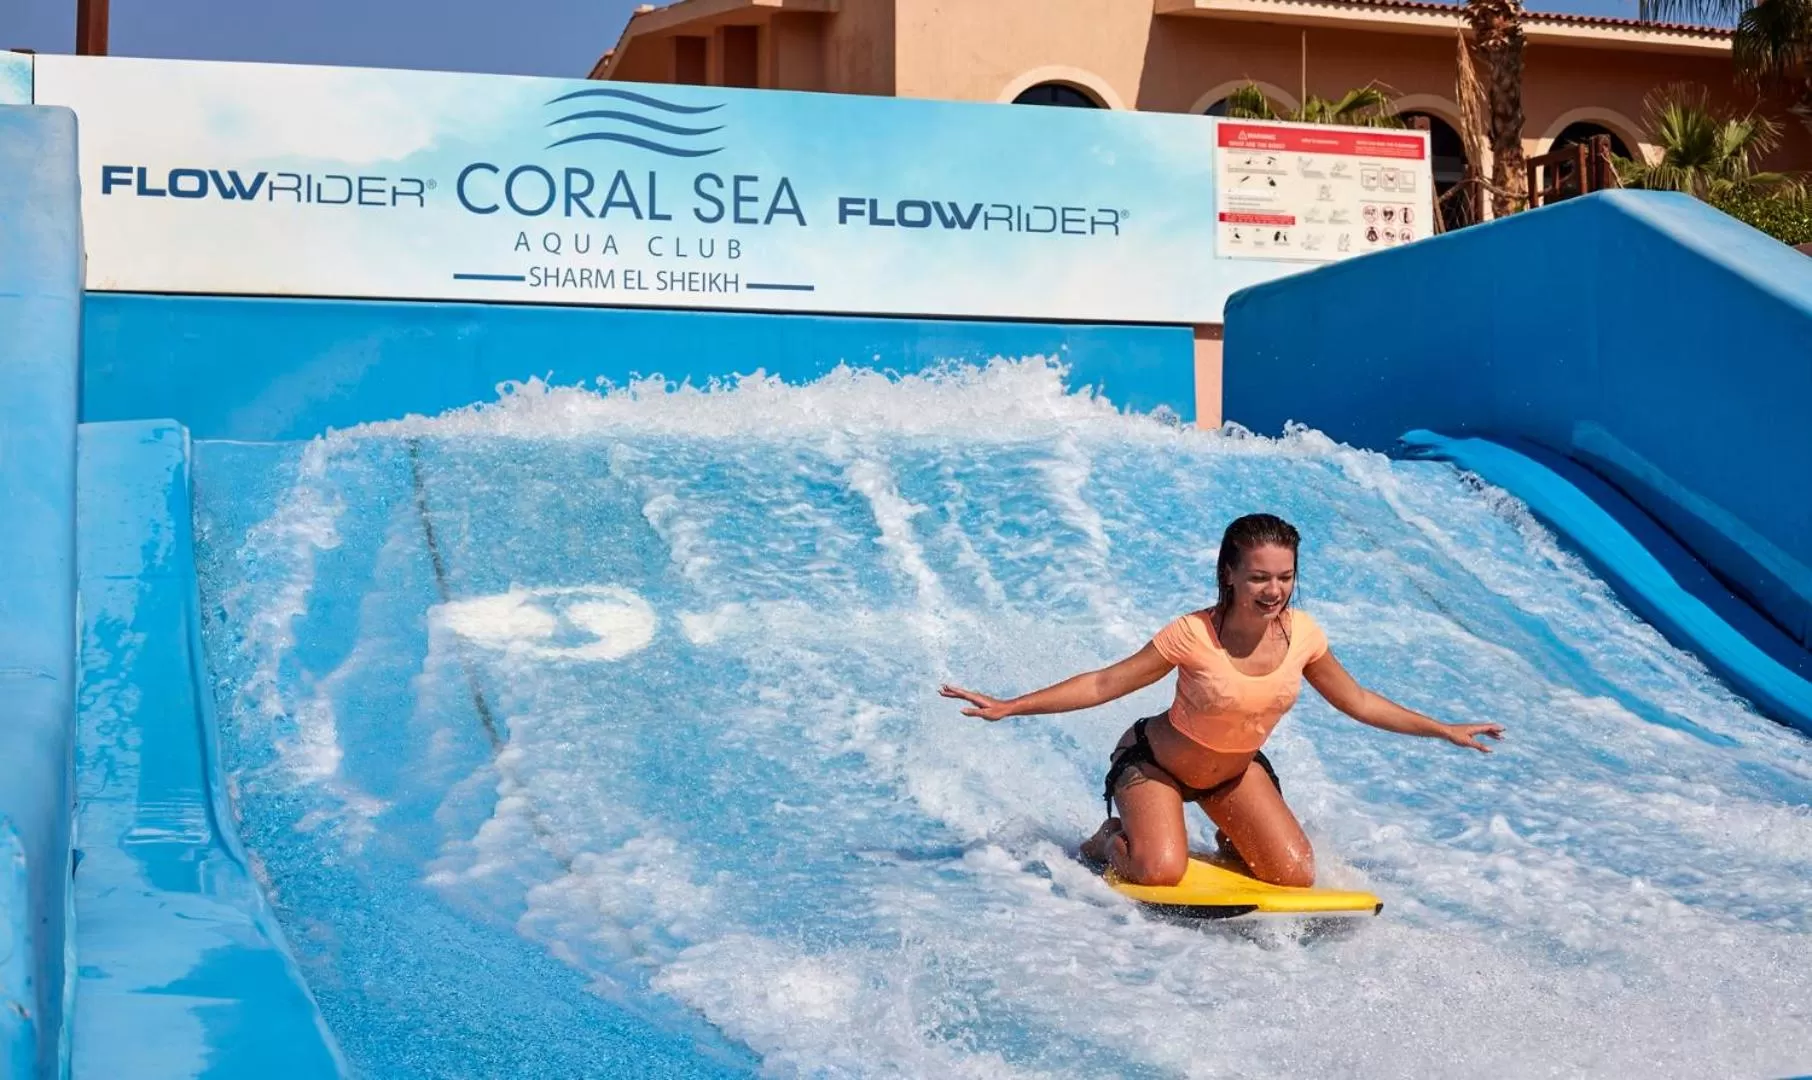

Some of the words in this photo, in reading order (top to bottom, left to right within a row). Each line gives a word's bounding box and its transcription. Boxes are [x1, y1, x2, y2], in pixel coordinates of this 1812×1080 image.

[456, 162, 673, 221] CORAL
[692, 172, 808, 227] SEA
[513, 230, 619, 256] AQUA
[647, 236, 742, 260] CLUB
[528, 266, 616, 289] SHARM
[623, 269, 649, 291] EL
[655, 270, 740, 294] SHEIKH
